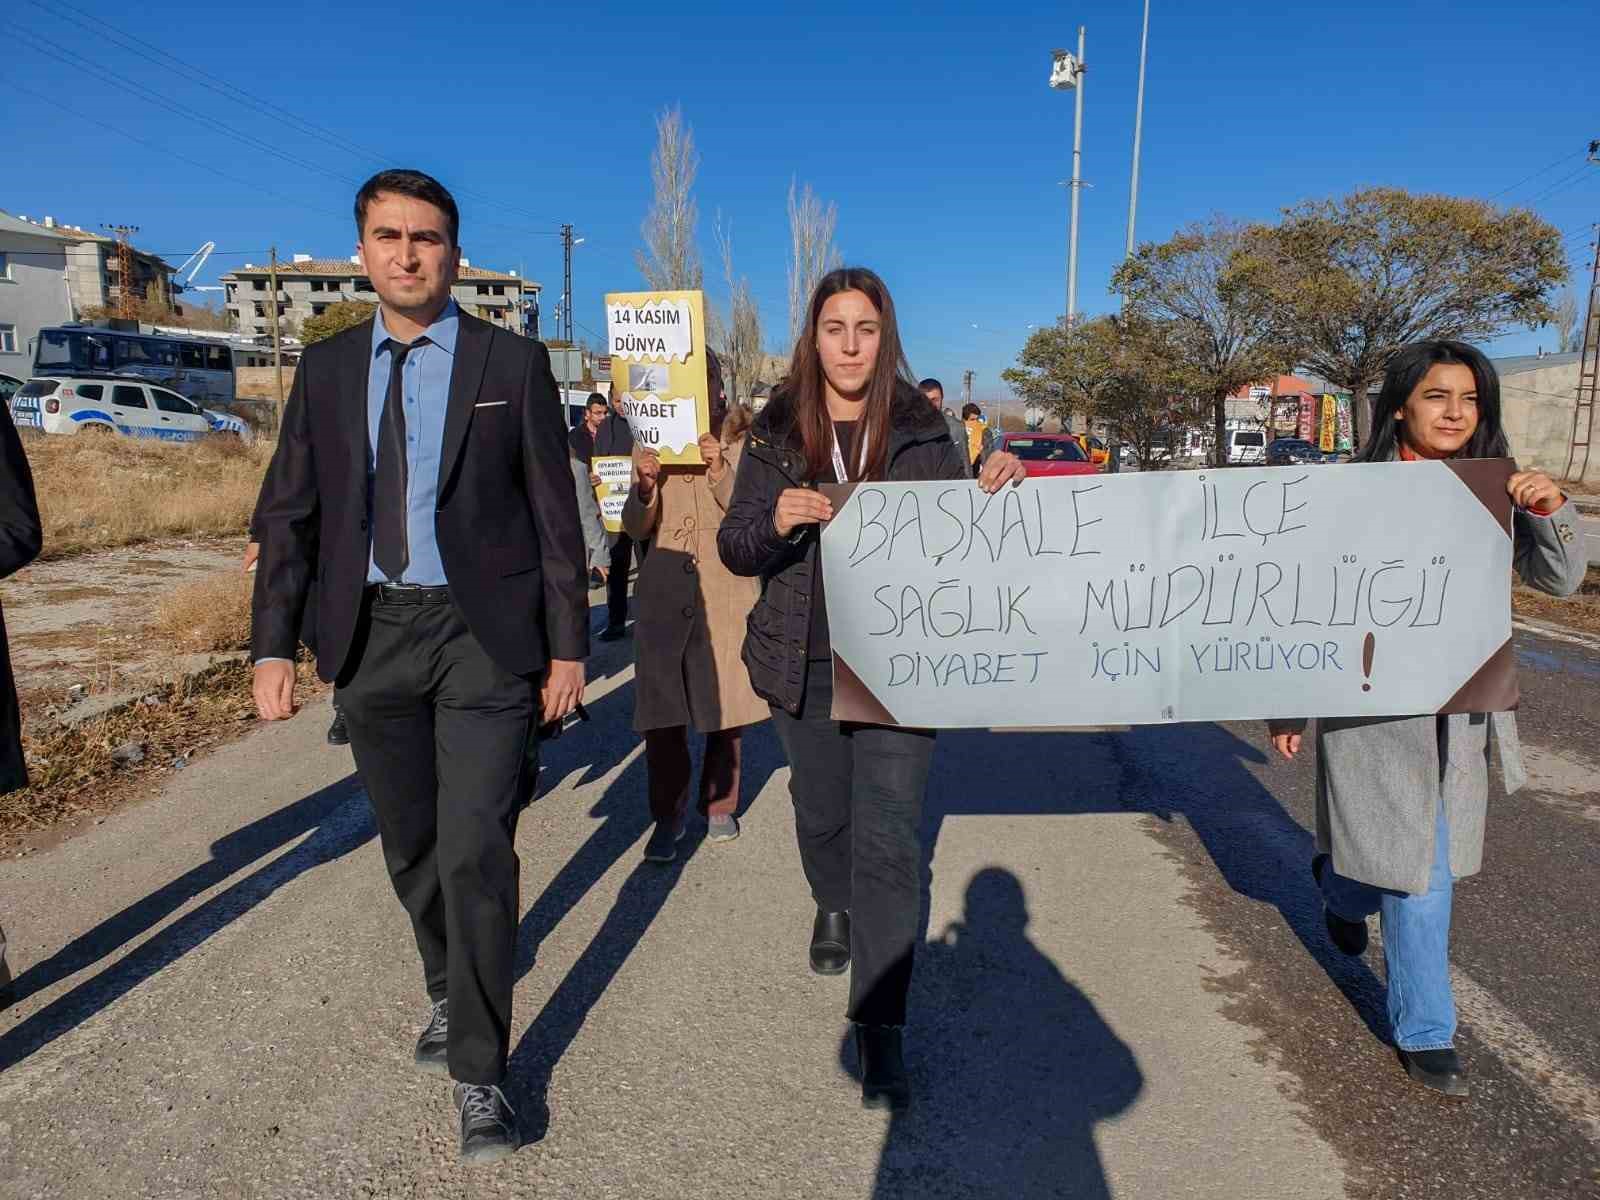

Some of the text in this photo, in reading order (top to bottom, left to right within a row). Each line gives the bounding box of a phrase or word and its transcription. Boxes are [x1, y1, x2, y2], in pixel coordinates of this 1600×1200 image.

[615, 309, 680, 325] 14 KASIM
[615, 335, 667, 353] DÜNYA
[624, 399, 677, 418] DİYABET
[632, 425, 659, 444] ÜNÜ
[849, 475, 1310, 567] BAŞKALE İLÇE
[869, 554, 1451, 638] SAĞLIK MÜDÜRLÜĞÜ
[887, 651, 1049, 687] DİYABET
[1090, 641, 1162, 682] İÇİN
[1190, 636, 1345, 674] YÜRÜYOR
